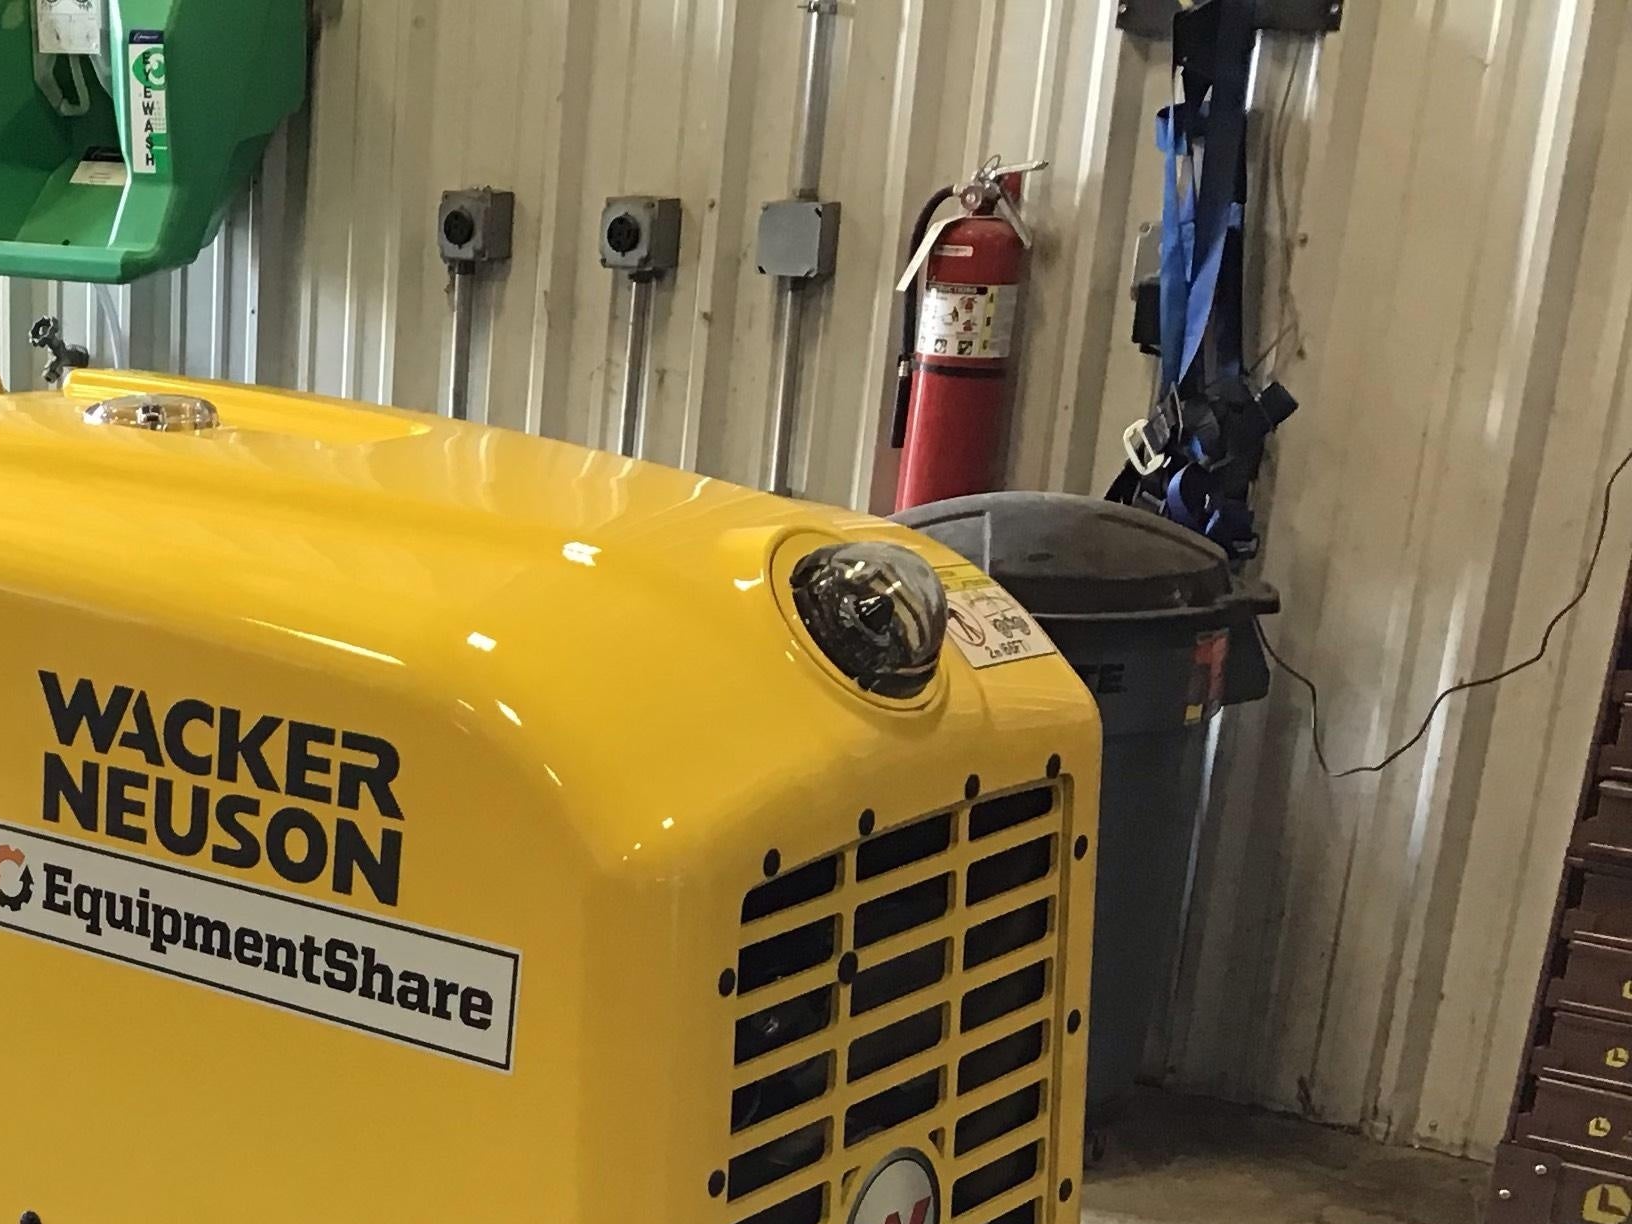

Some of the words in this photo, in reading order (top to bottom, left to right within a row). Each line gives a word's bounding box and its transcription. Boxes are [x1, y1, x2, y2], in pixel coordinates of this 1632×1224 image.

[142, 51, 155, 166] EYEWASH
[38, 669, 405, 821] WACKER
[43, 752, 403, 907] NEUSON
[42, 863, 495, 1031] EquipmentShare
